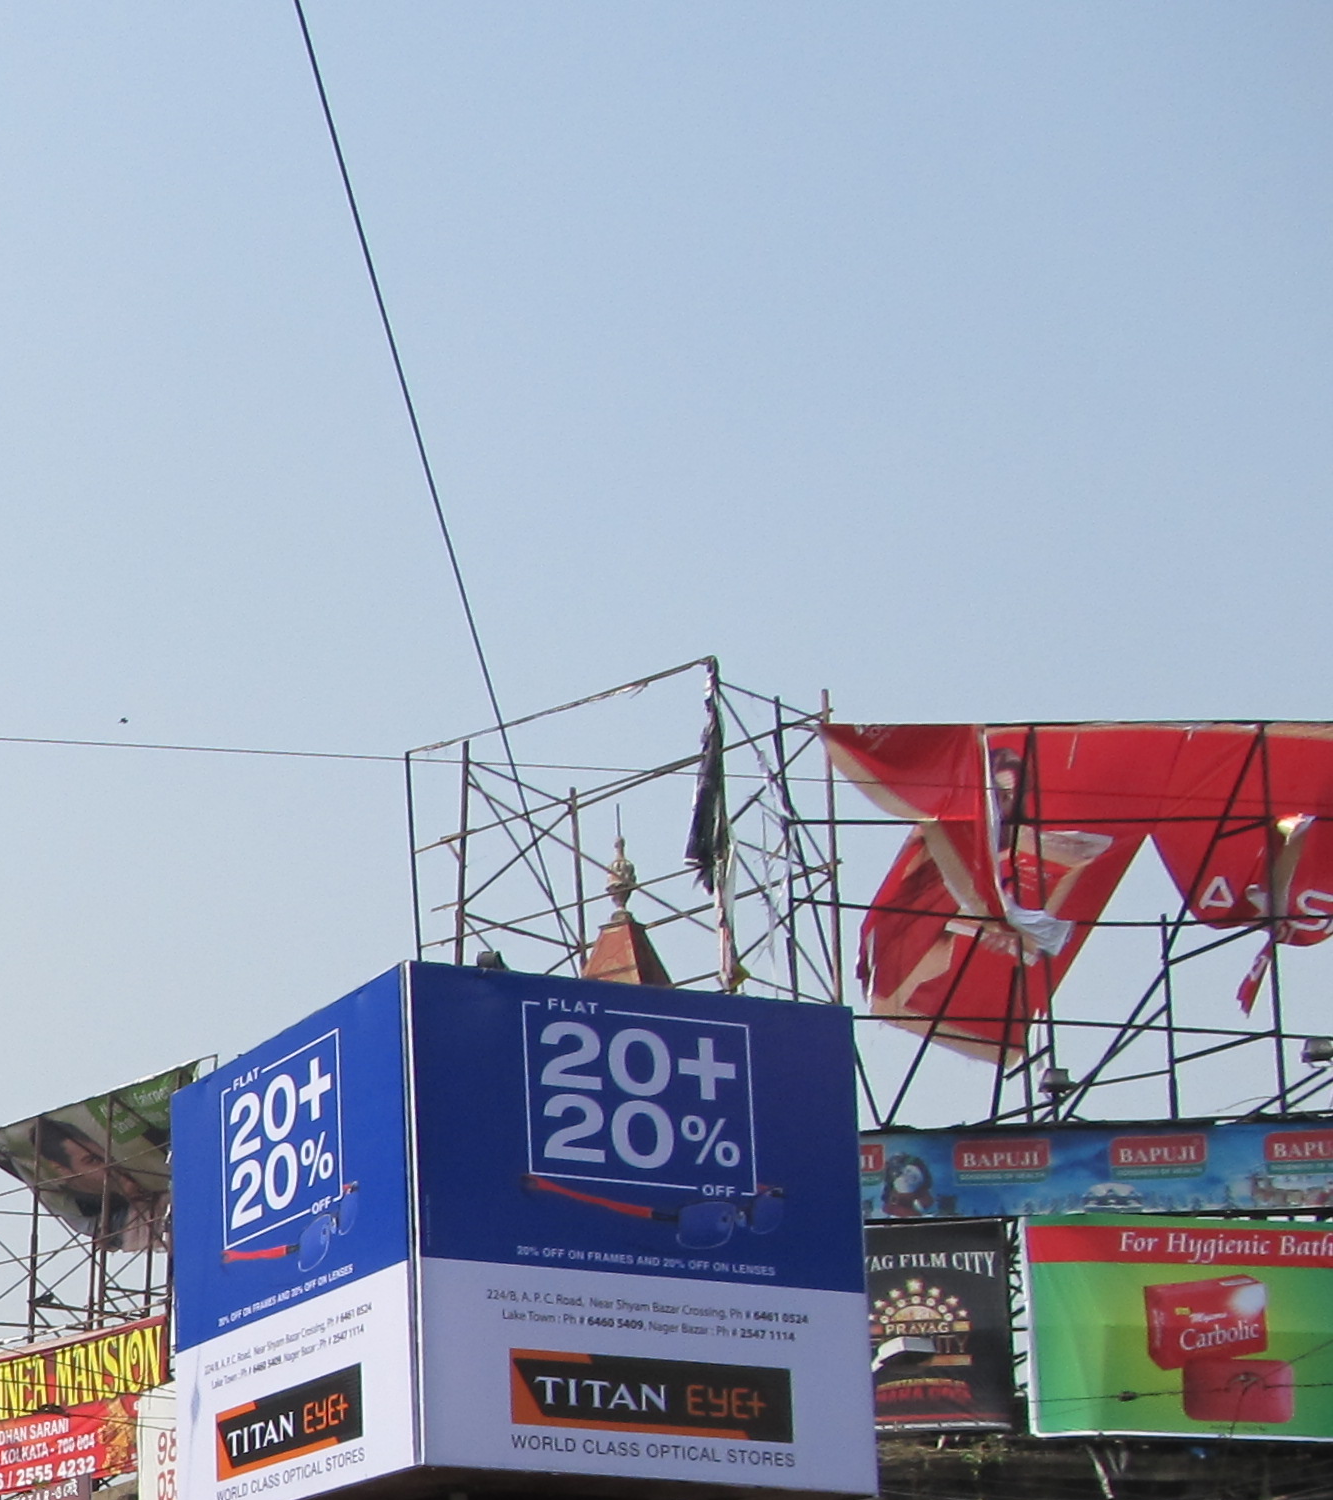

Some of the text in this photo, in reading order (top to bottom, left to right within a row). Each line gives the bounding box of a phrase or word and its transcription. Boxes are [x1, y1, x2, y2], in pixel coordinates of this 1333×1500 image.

[548, 999, 599, 1016] FLAT
[540, 1020, 737, 1100] 20+
[233, 1066, 260, 1090] FLAT
[229, 1056, 332, 1164] 20+
[542, 1094, 741, 1170] 20%
[963, 1141, 1333, 1168] BAPUJI BAPUJI BAPU
[231, 1131, 334, 1230] 20%
[701, 1182, 737, 1199] OFF
[311, 1195, 331, 1215] OFF
[542, 1247, 565, 1259] OFF
[567, 1249, 585, 1261] ON
[587, 1250, 634, 1265] FRAMES
[636, 1255, 661, 1267] AND
[688, 1259, 711, 1271] OFF
[712, 1261, 730, 1273] ON
[731, 1263, 776, 1276] LENSES
[1119, 1231, 1159, 1253] For
[1166, 1232, 1271, 1264] Hygienic
[899, 1251, 996, 1279] FILM CITY
[501, 1308, 527, 1322] Lake
[528, 1310, 555, 1323] Town
[562, 1312, 577, 1325] Ph
[589, 1297, 614, 1310] Near
[616, 1298, 650, 1314] Shyam
[651, 1301, 681, 1315] Bazar
[729, 1307, 743, 1320] Ph
[885, 1322, 950, 1336] PRAYAG
[1179, 1319, 1260, 1351] Carbolic
[54, 1322, 167, 1407] MANSION
[535, 1374, 668, 1413] TITAN
[29, 1418, 70, 1440] SARANI
[226, 1410, 295, 1458] TITAN
[0, 1443, 50, 1464] KOLKATA
[511, 1433, 796, 1469] WORLD CLASS OPTICAL STORES
[16, 1463, 53, 1486] 2555
[56, 1455, 97, 1478] 4232
[250, 1471, 281, 1497] CLASS
[282, 1461, 323, 1486] OPTICAL
[326, 1446, 366, 1472] STORES
[63, 1479, 79, 1497] সেই
